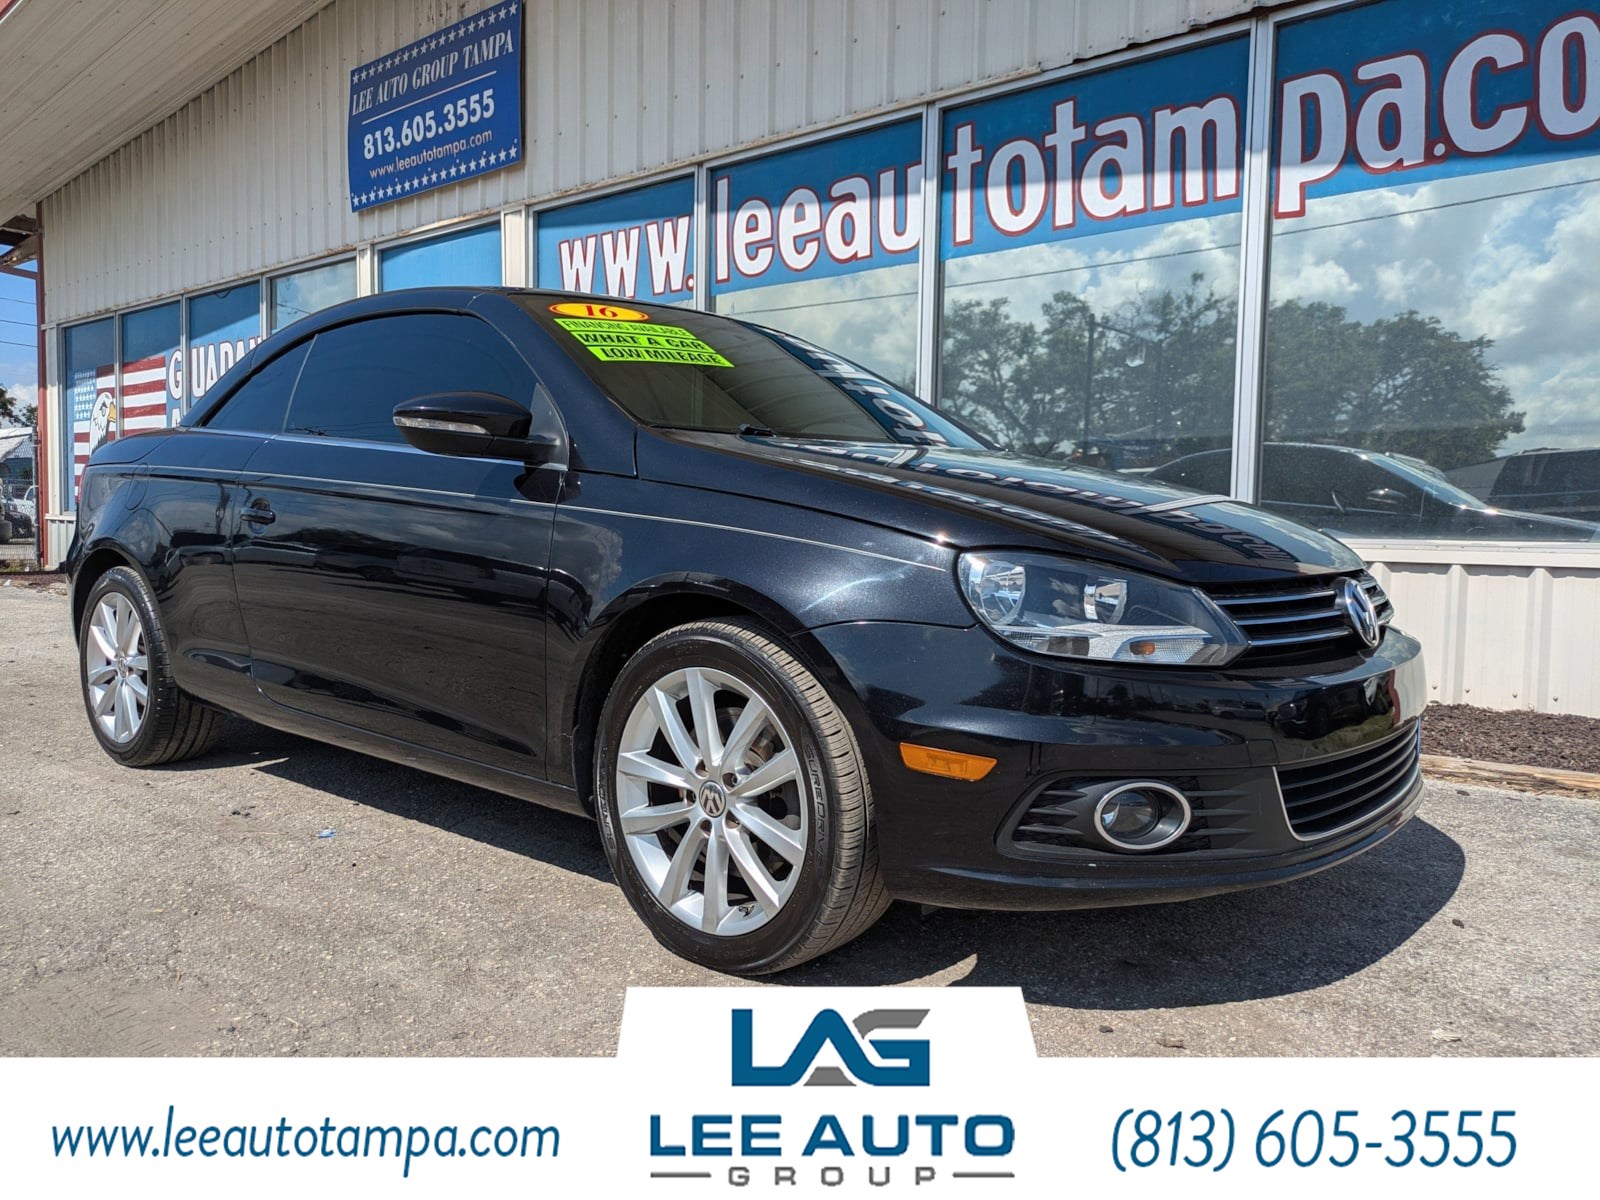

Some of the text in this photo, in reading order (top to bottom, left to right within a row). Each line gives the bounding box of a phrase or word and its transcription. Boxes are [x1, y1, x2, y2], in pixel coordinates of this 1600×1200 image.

[352, 29, 514, 116] LEE AUTO GROUP TAMPA
[363, 88, 496, 160] 813.605.3555
[369, 129, 493, 179] www.leeautotampa.com
[585, 305, 618, 318] 16
[578, 333, 707, 351] WHAT A CAR
[601, 347, 723, 365] LOW MILEAGE
